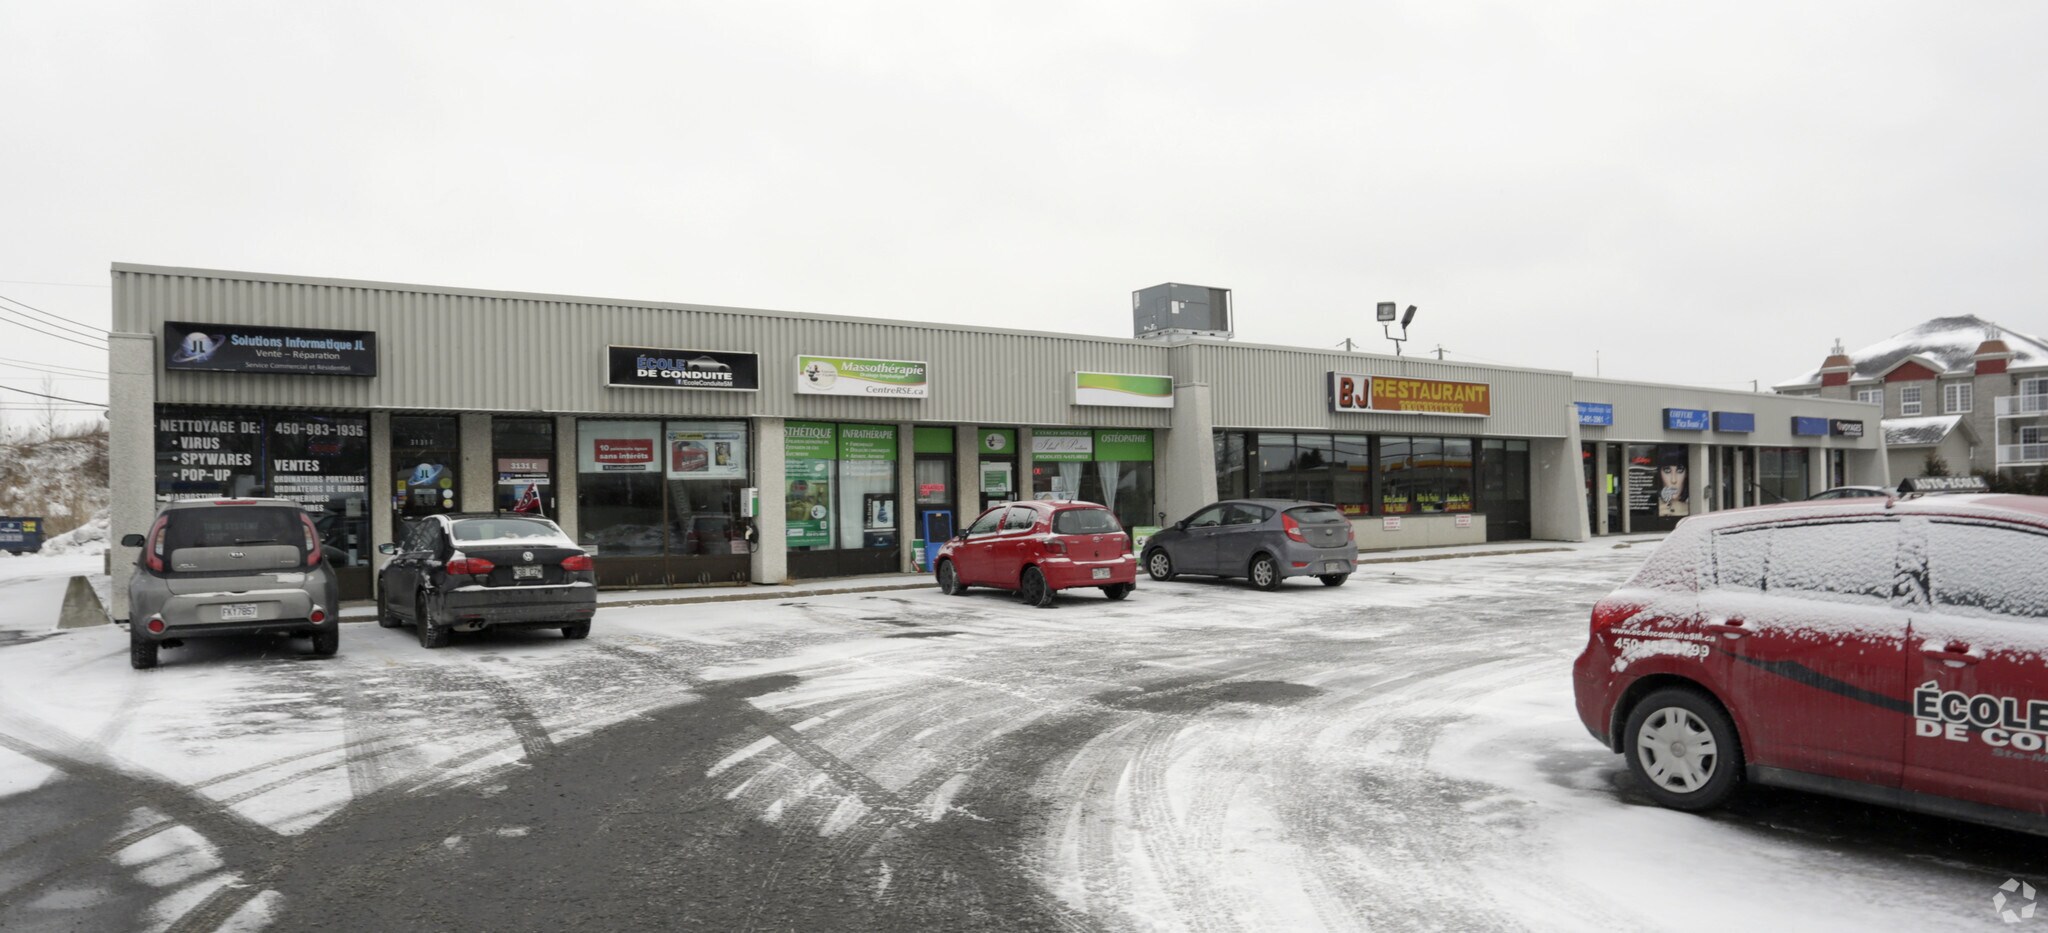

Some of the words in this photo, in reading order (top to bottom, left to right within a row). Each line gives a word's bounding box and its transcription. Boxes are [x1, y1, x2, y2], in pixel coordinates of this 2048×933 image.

[191, 340, 205, 353] JL
[231, 335, 282, 348] Solutions
[286, 337, 352, 351] Informatique
[354, 340, 365, 350] JL
[256, 350, 282, 358] Vente
[293, 351, 340, 361] Réparation
[270, 362, 308, 370] Commercial
[637, 355, 685, 371] ÉCOLE
[841, 362, 923, 376] Massothérapie
[637, 369, 657, 377] DE
[661, 370, 732, 380] CONDUITE
[866, 386, 923, 395] CentreRSE.ca
[1373, 378, 1486, 402] RESTAURANT
[161, 419, 235, 433] NETTOYAGE
[241, 422, 260, 434] DE:
[275, 423, 363, 436] 450-983-1935
[784, 425, 832, 438] STHÉTIQUE
[181, 437, 220, 449] VIRUS
[1101, 433, 1146, 443] OSTÉOPATHIE
[181, 453, 252, 466] SPYWARES
[274, 459, 320, 472] VENTES
[181, 469, 231, 481] POP-UP
[274, 485, 323, 493] ORDINATEURS
[1914, 680, 2048, 735] ÉCOLE
[1916, 719, 1969, 742] DE
[1981, 728, 2048, 753] CO
